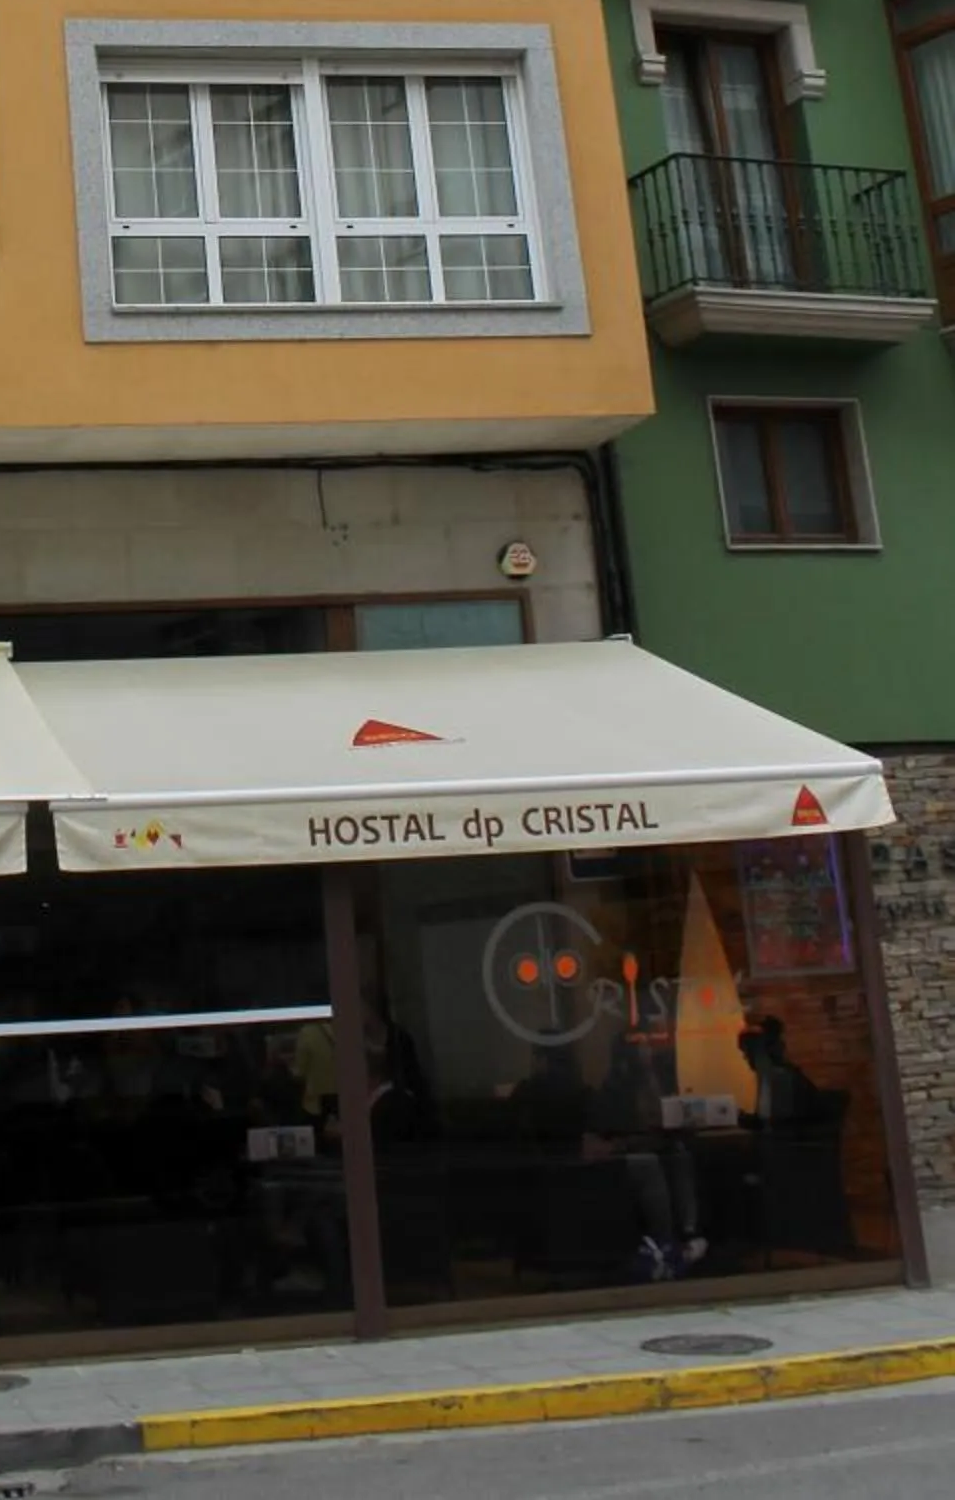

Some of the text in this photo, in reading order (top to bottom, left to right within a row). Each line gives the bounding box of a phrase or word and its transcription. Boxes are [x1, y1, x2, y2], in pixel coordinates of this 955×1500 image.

[308, 801, 660, 847] HOSTAL dp CRISTAL
